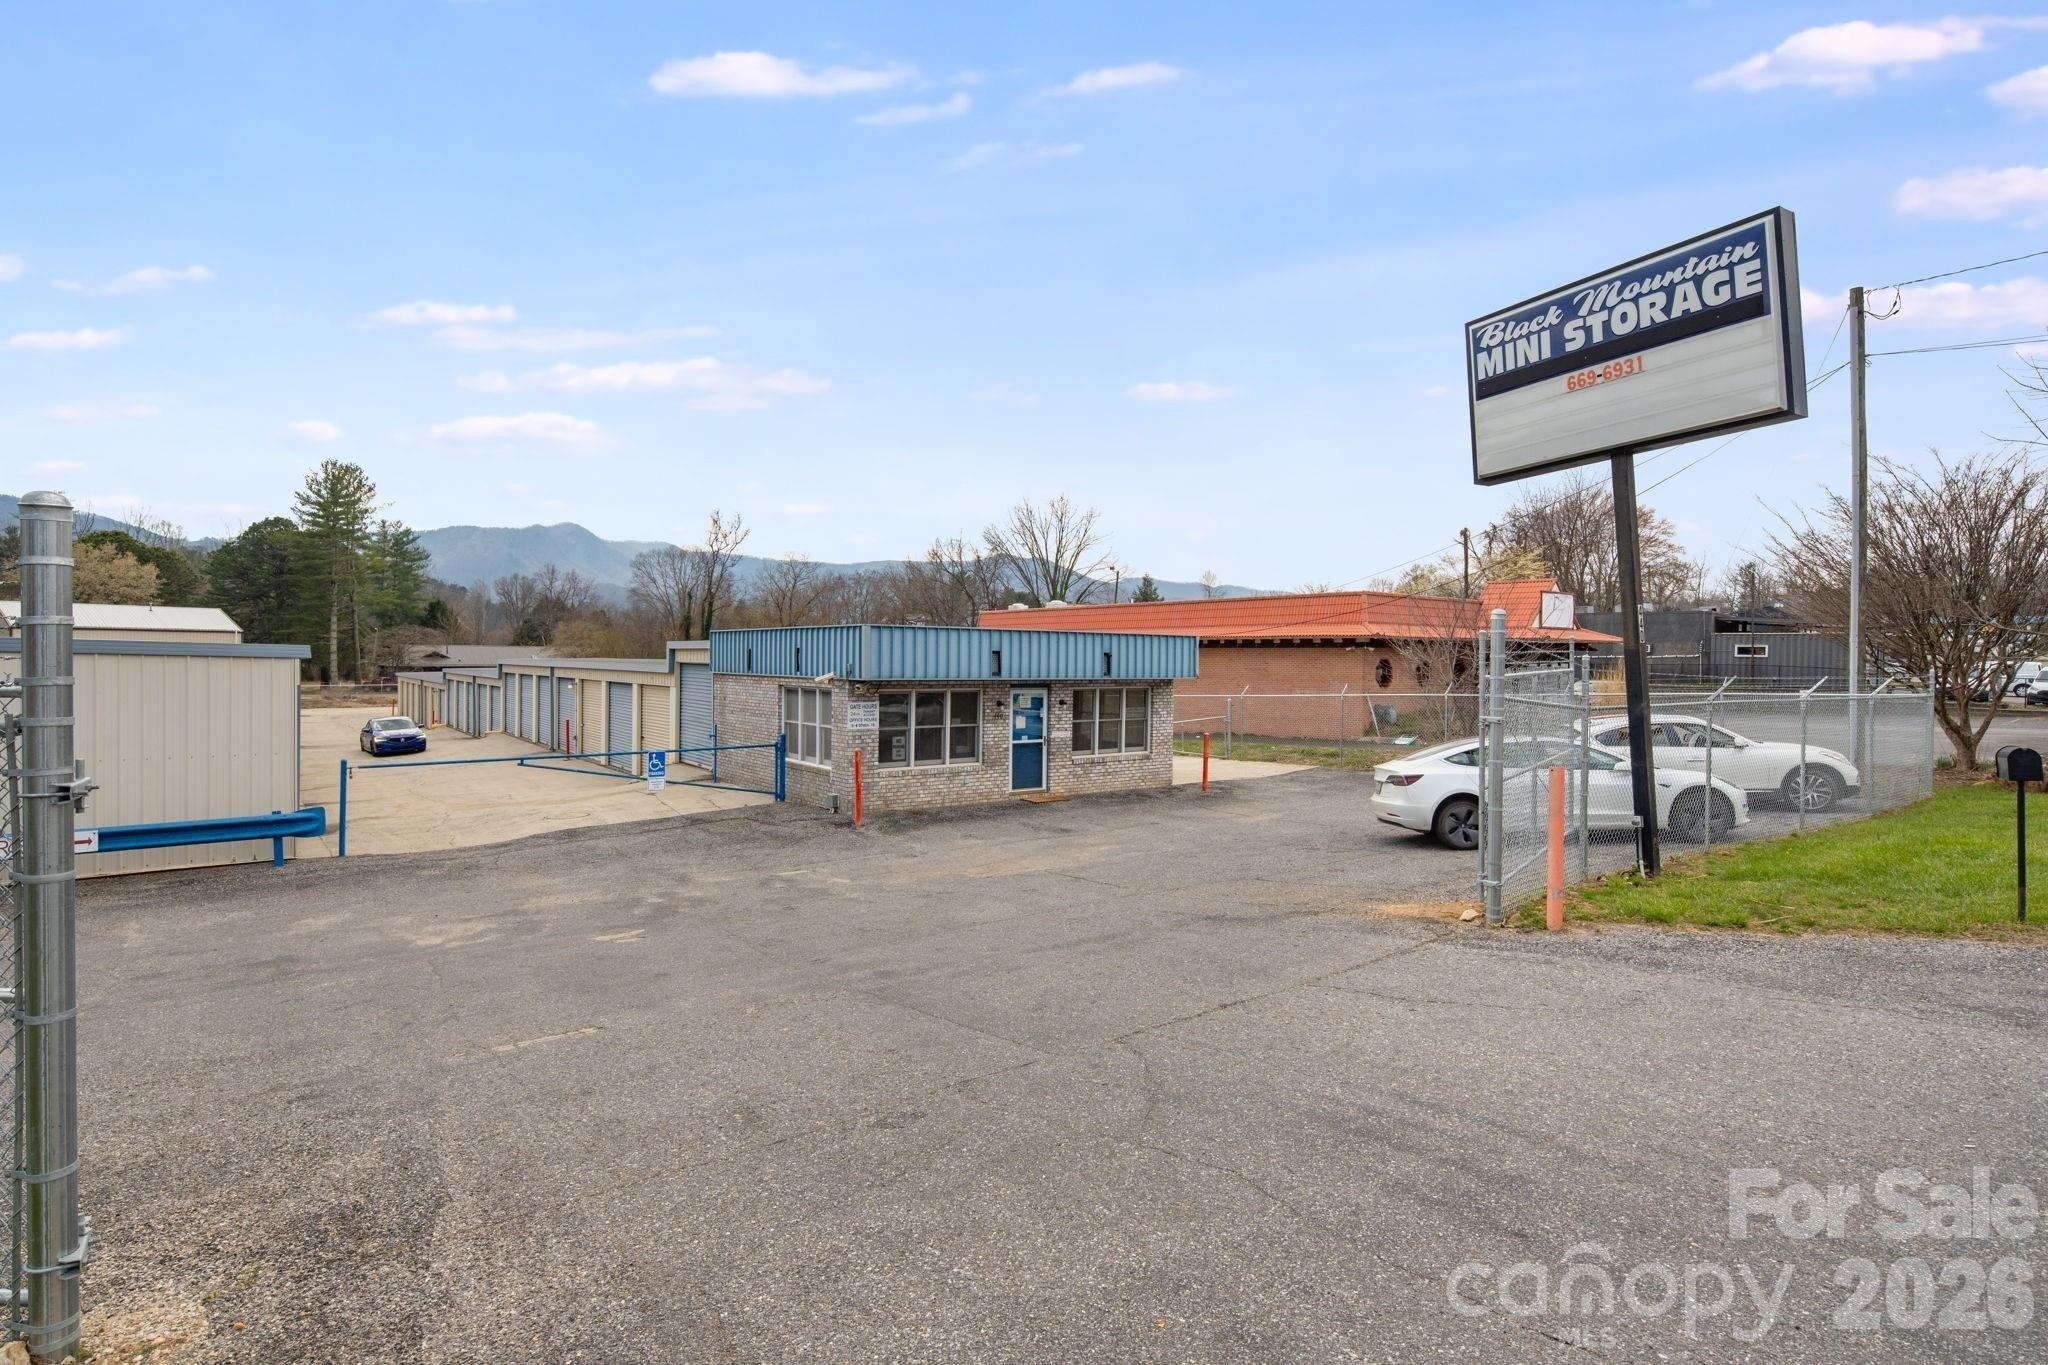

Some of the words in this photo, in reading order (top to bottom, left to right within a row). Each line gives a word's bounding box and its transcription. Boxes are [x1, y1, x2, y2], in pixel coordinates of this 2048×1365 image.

[1476, 305, 1565, 349] Black
[1573, 241, 1760, 317] Mountain
[1476, 330, 1552, 382] MINI
[1563, 258, 1763, 353] STORAGE
[1566, 355, 1644, 391] 669-6931
